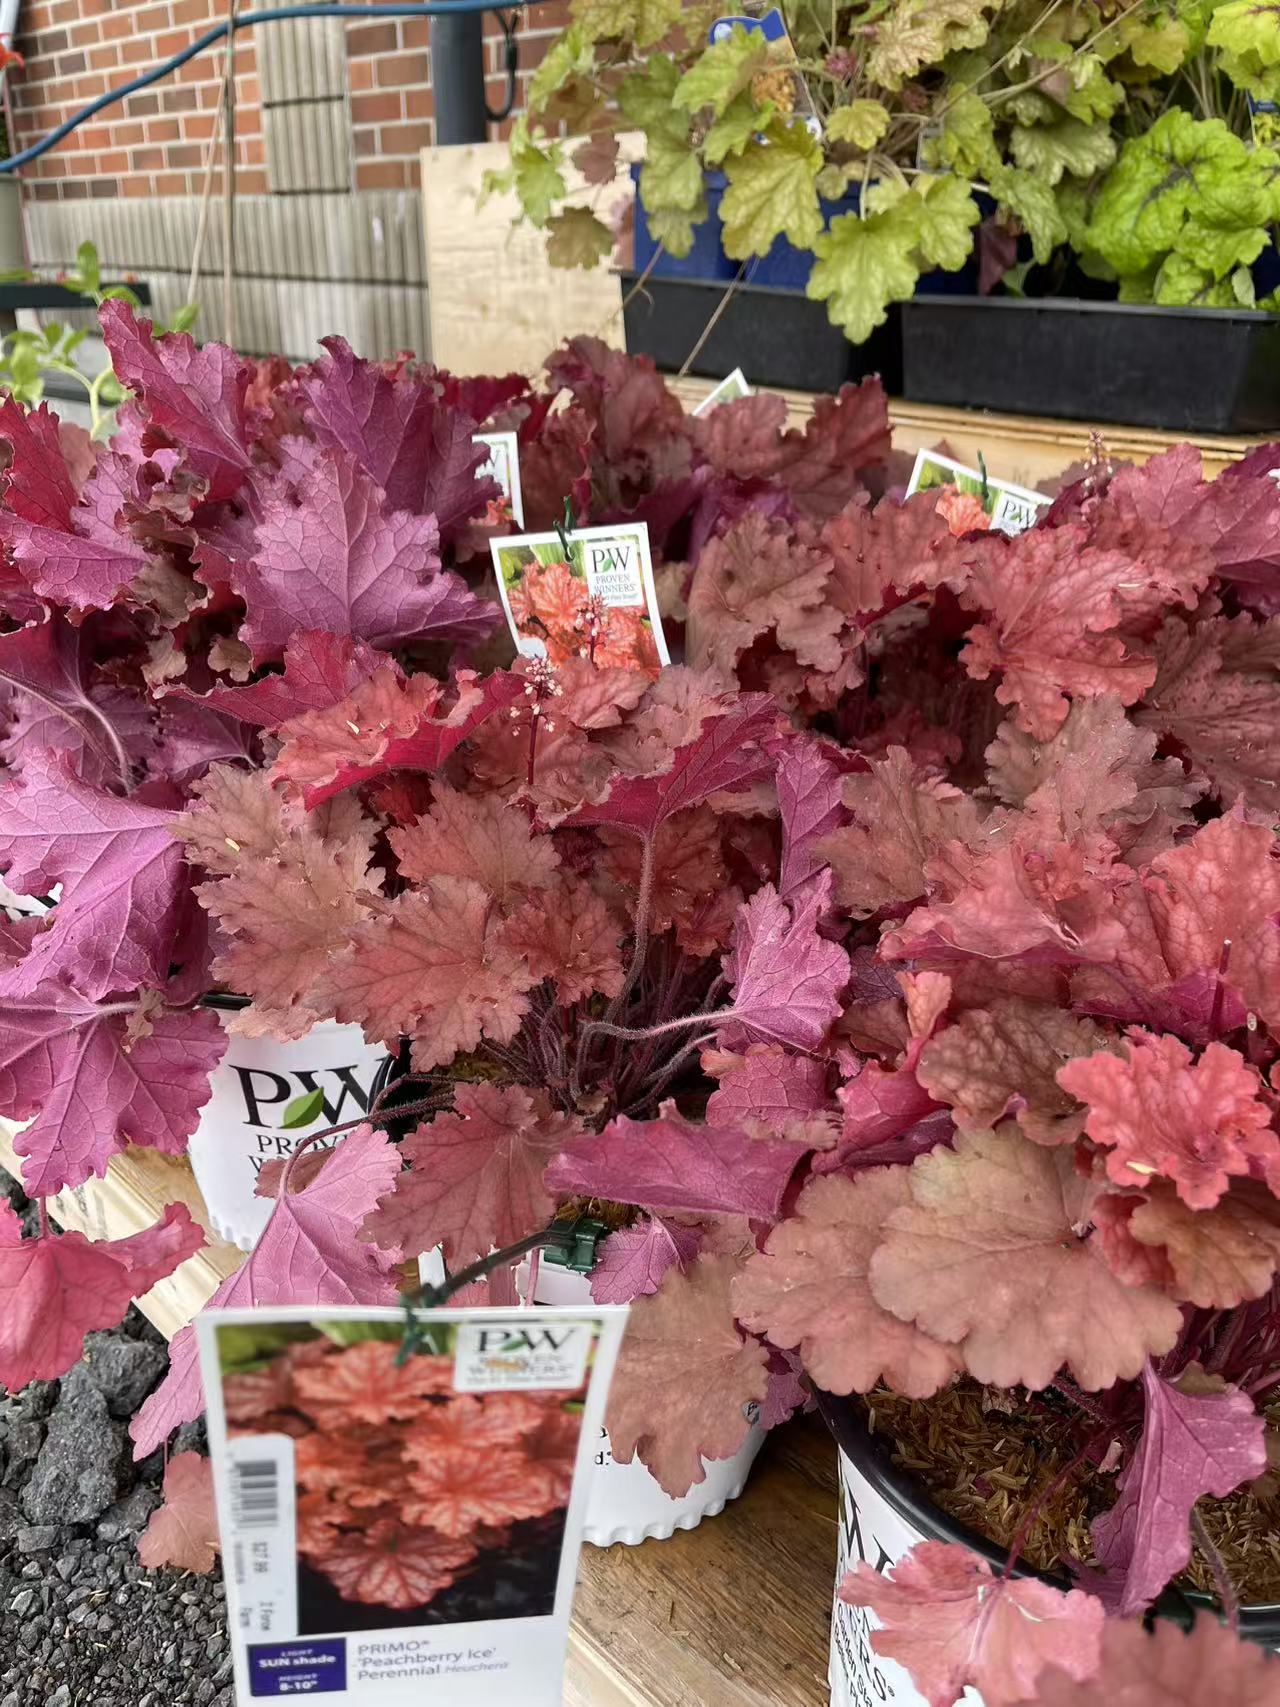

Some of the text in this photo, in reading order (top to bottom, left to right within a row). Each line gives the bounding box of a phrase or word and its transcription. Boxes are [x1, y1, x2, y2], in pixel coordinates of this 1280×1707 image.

[591, 545, 630, 574] PW
[595, 573, 631, 585] PROVEN
[228, 1056, 386, 1129] PW
[478, 1327, 576, 1352] PW
[258, 1654, 337, 1668] SUN shade
[357, 1661, 510, 1681] Perennial Heuchera
